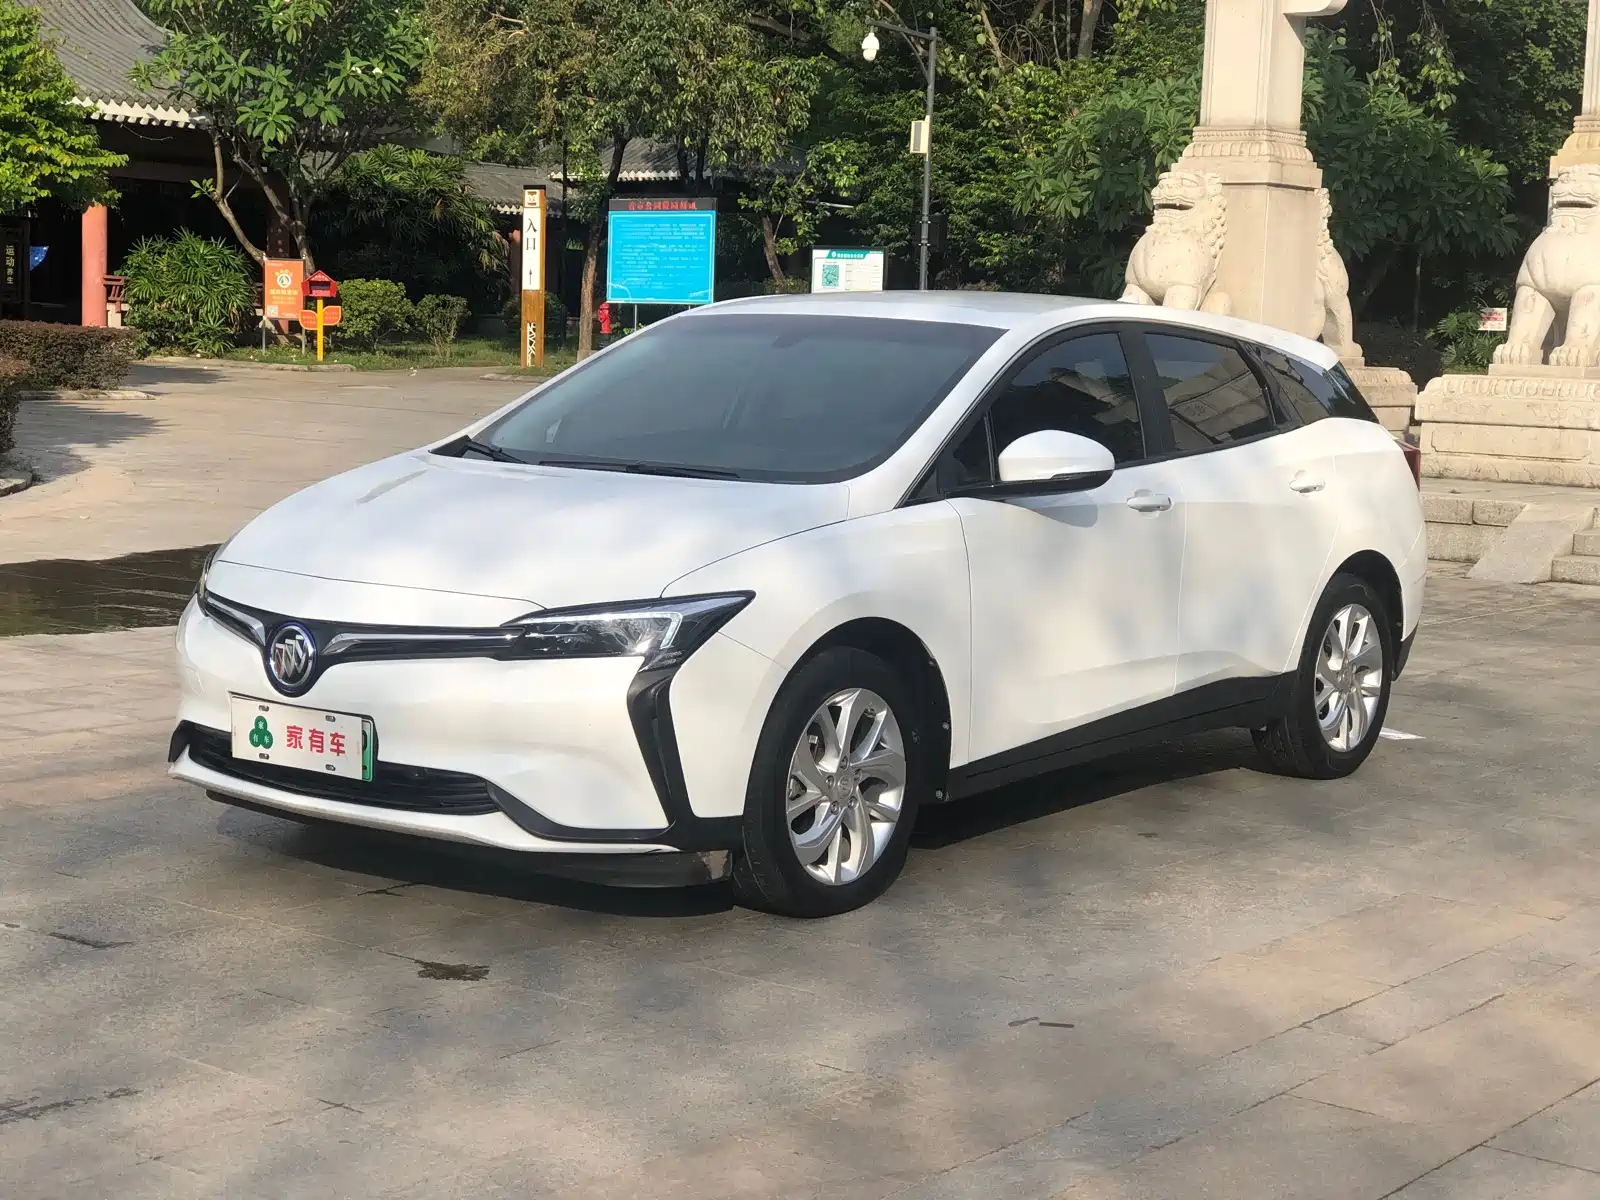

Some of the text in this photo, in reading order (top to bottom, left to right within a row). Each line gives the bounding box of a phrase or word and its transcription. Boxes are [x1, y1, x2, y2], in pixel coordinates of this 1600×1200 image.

[526, 217, 537, 251] 入口
[286, 724, 346, 757] 家有车
